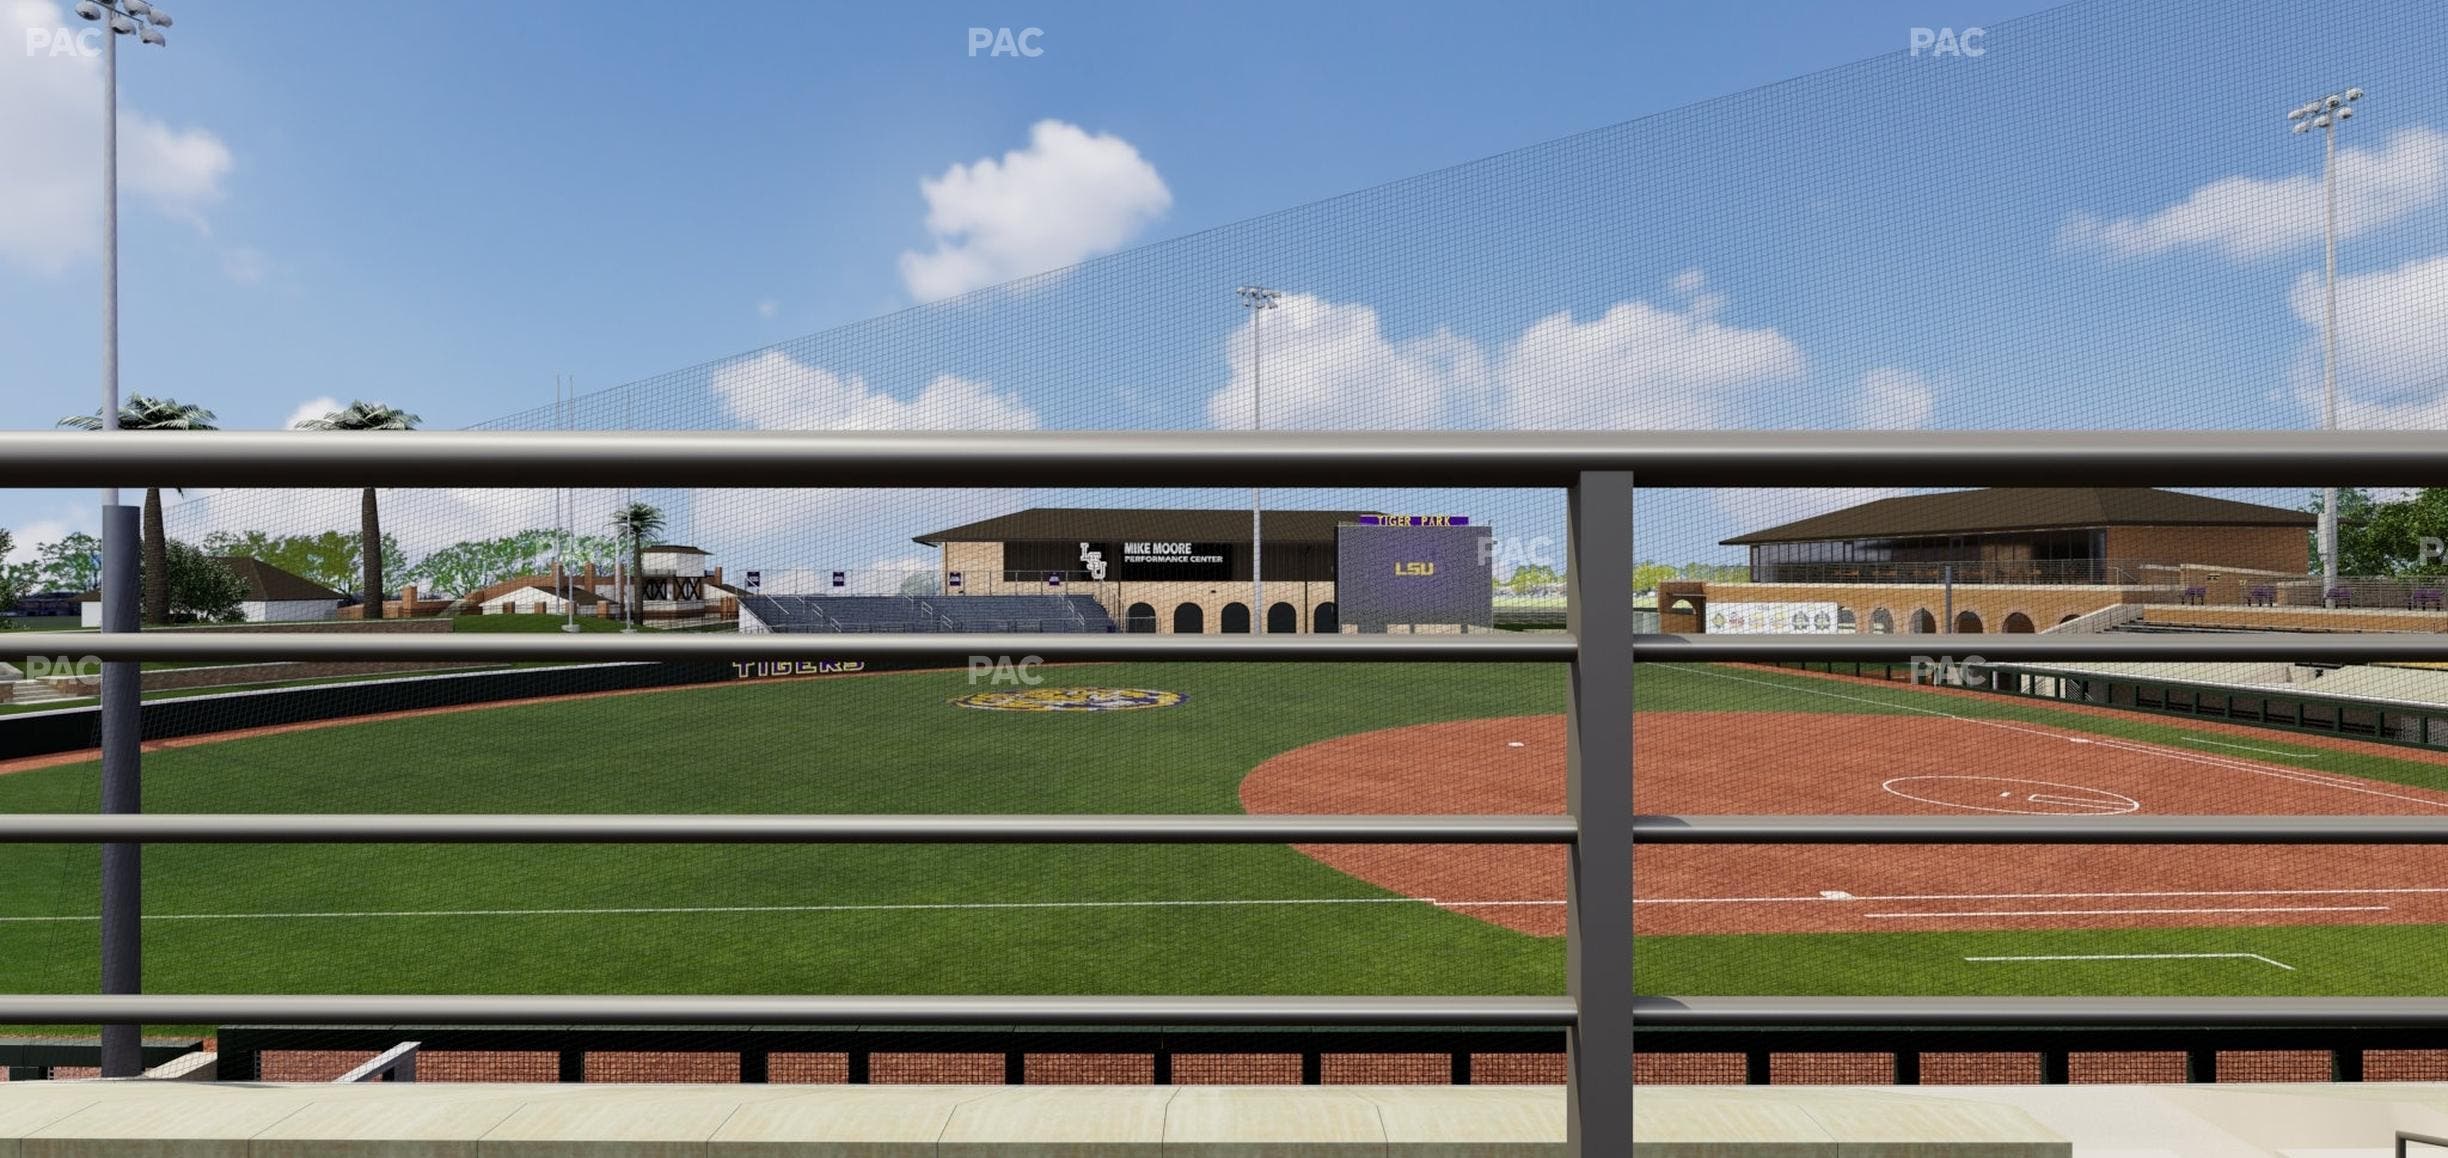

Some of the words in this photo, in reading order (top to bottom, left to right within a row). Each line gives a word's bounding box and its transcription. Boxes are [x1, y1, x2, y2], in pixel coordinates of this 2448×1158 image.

[1376, 514, 1412, 527] TIGER
[1421, 514, 1451, 527] PARK
[1124, 542, 1151, 555] MIKE
[1153, 542, 1192, 555] MOORE
[1124, 555, 1189, 563] PERFORMANCE
[1190, 555, 1224, 563] CENTER
[1394, 561, 1435, 577] LSU
